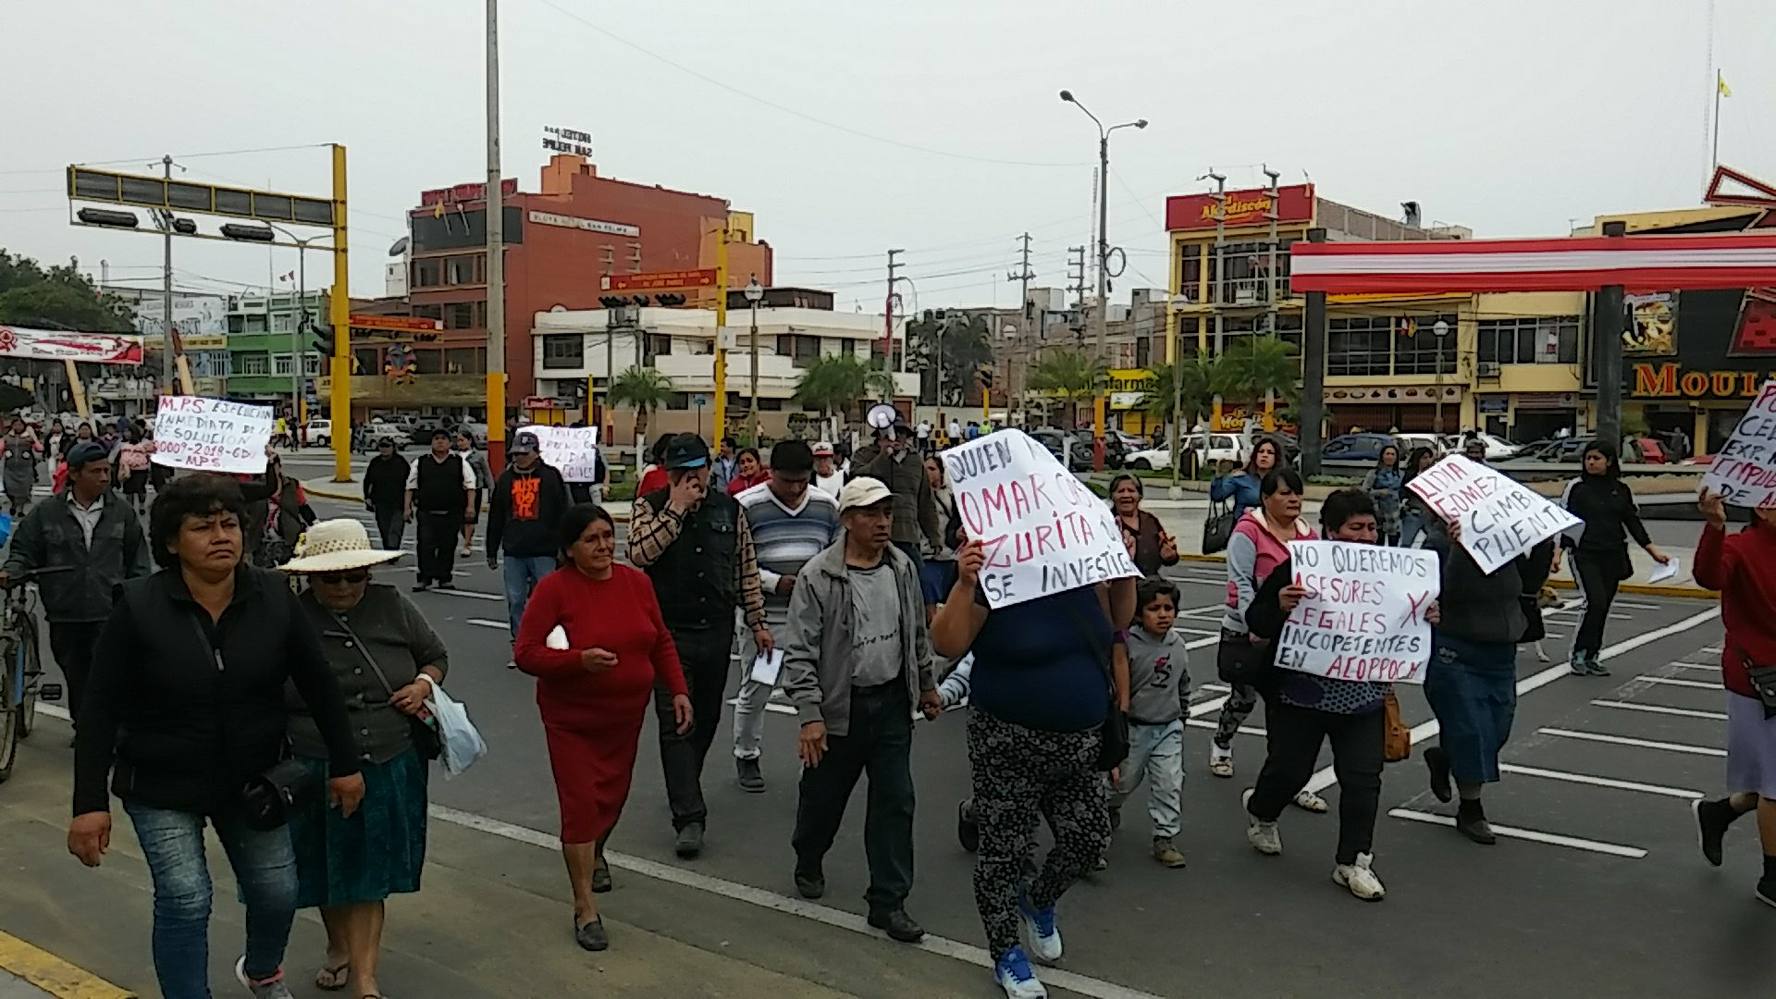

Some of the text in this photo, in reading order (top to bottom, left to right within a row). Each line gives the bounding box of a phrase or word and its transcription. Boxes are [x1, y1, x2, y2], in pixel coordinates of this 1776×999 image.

[947, 436, 1012, 483] QUIEN
[1411, 462, 1468, 499] LIDIA
[1435, 475, 1498, 519] GOMEZ
[960, 473, 1055, 535] OMAR
[1292, 544, 1427, 577] NO QUEREMOS
[983, 573, 1016, 602] SE
[1278, 647, 1307, 667] EN
[1282, 625, 1421, 655] INCOPETENTES
